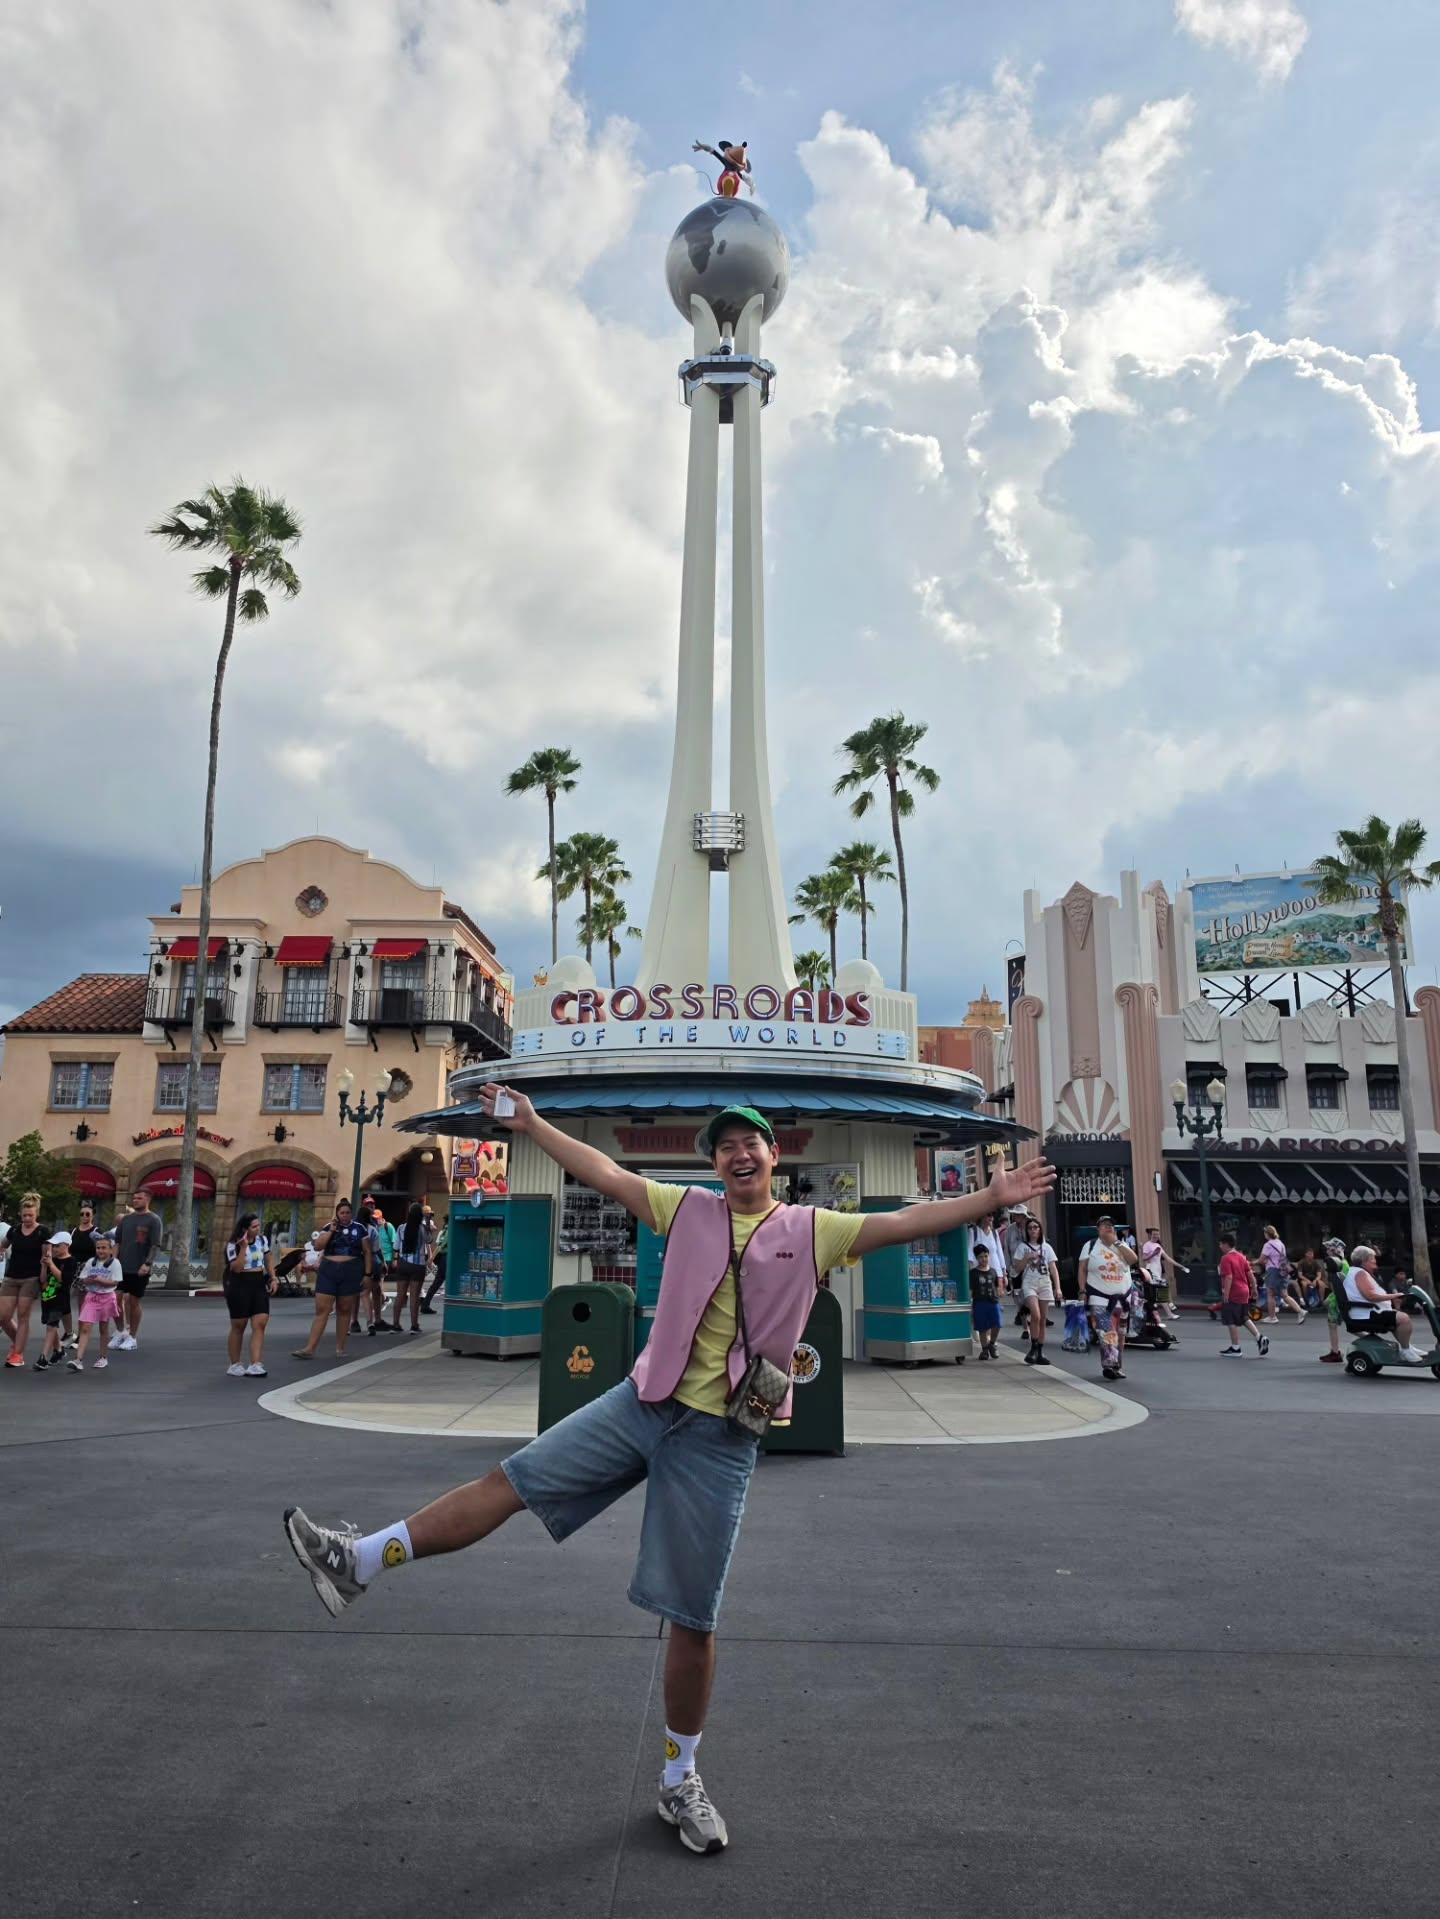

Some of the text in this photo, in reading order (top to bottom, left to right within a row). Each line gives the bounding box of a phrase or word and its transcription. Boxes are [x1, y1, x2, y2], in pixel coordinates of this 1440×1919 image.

[1203, 884, 1382, 946] Hollywoon
[551, 983, 872, 1026] CROSSROADS
[571, 1025, 847, 1046] OF THE WORLD
[805, 1367, 818, 1381] CLEAN
[326, 1549, 341, 1568] N
[669, 1801, 679, 1815] N
